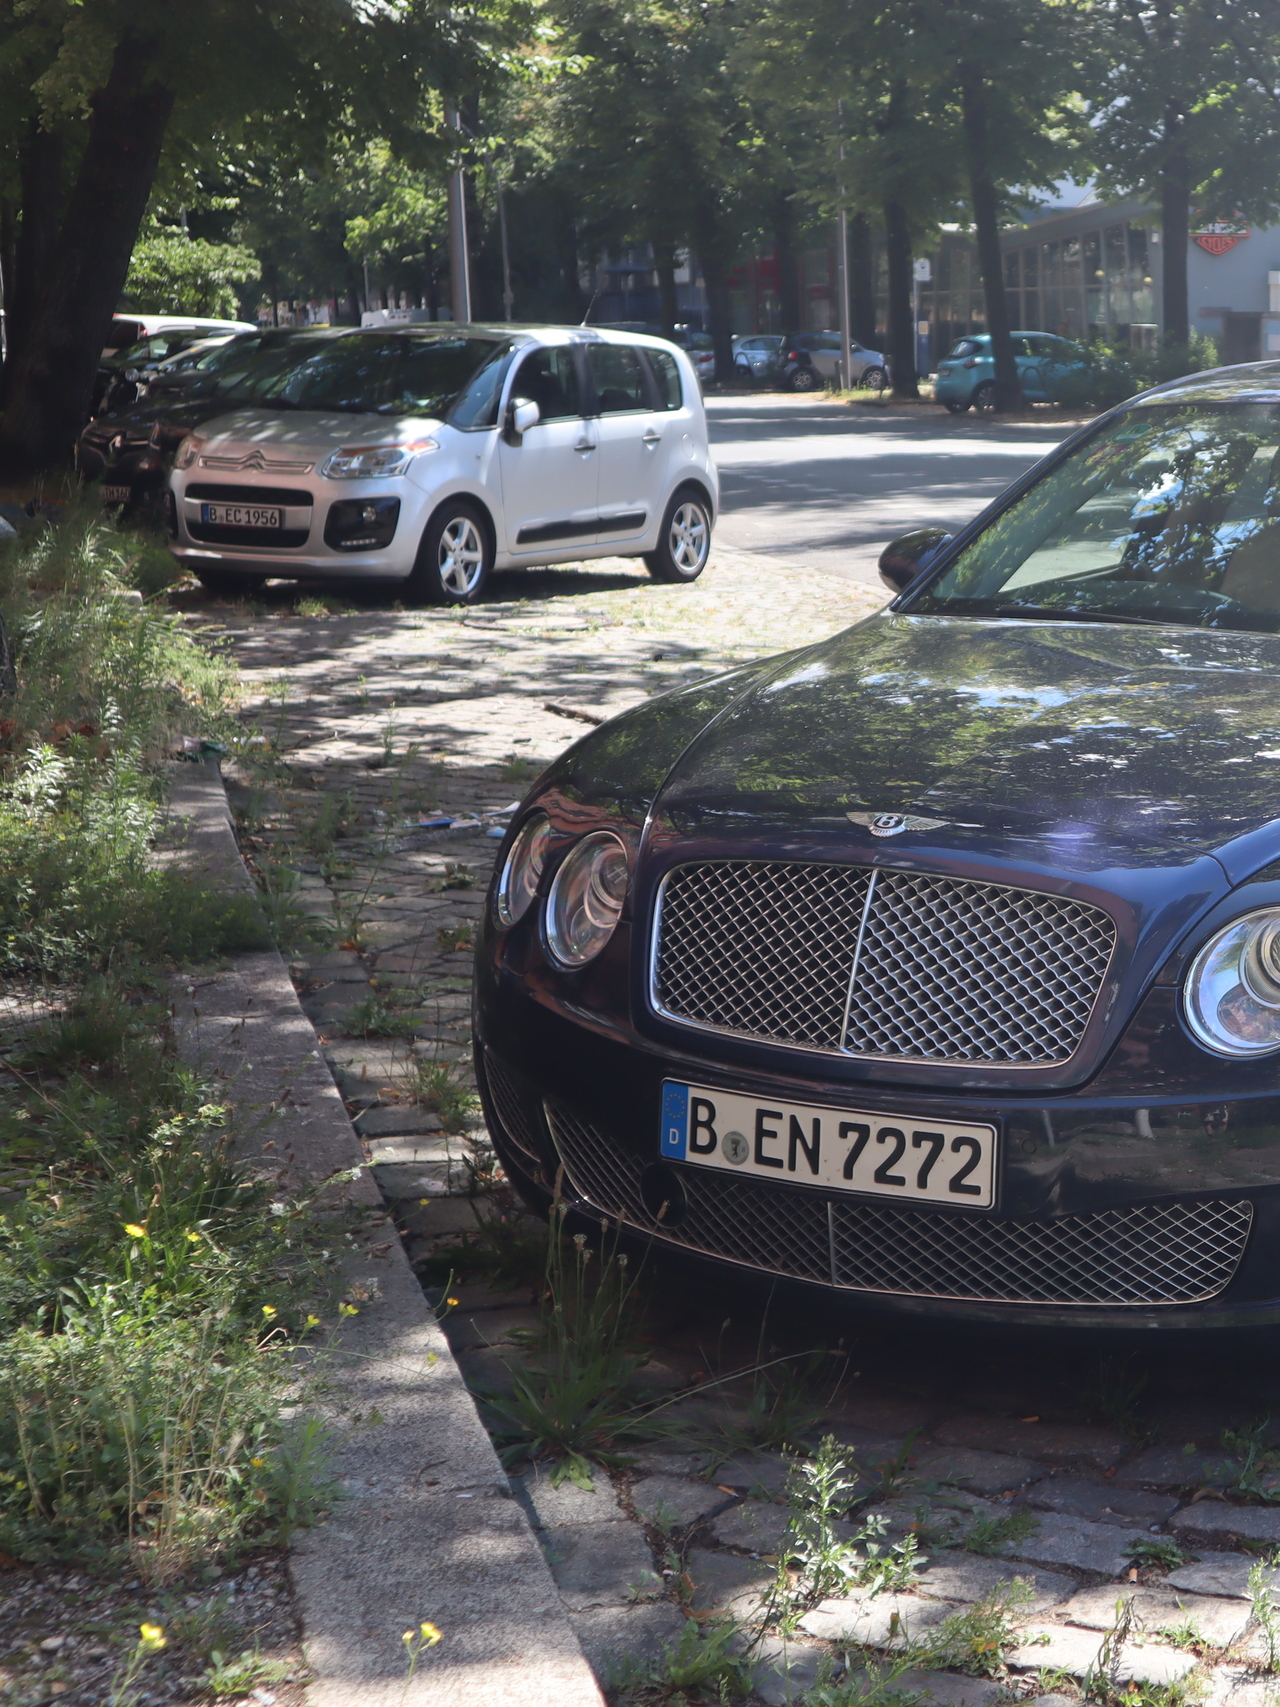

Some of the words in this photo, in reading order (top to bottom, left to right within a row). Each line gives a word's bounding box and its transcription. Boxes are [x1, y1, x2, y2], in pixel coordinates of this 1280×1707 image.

[209, 506, 218, 522] B
[225, 508, 242, 524] EC
[245, 509, 277, 526] 1956
[876, 815, 899, 828] B
[668, 1127, 680, 1145] D
[688, 1096, 718, 1155] B
[754, 1108, 821, 1176] EN
[838, 1121, 983, 1196] 7272
